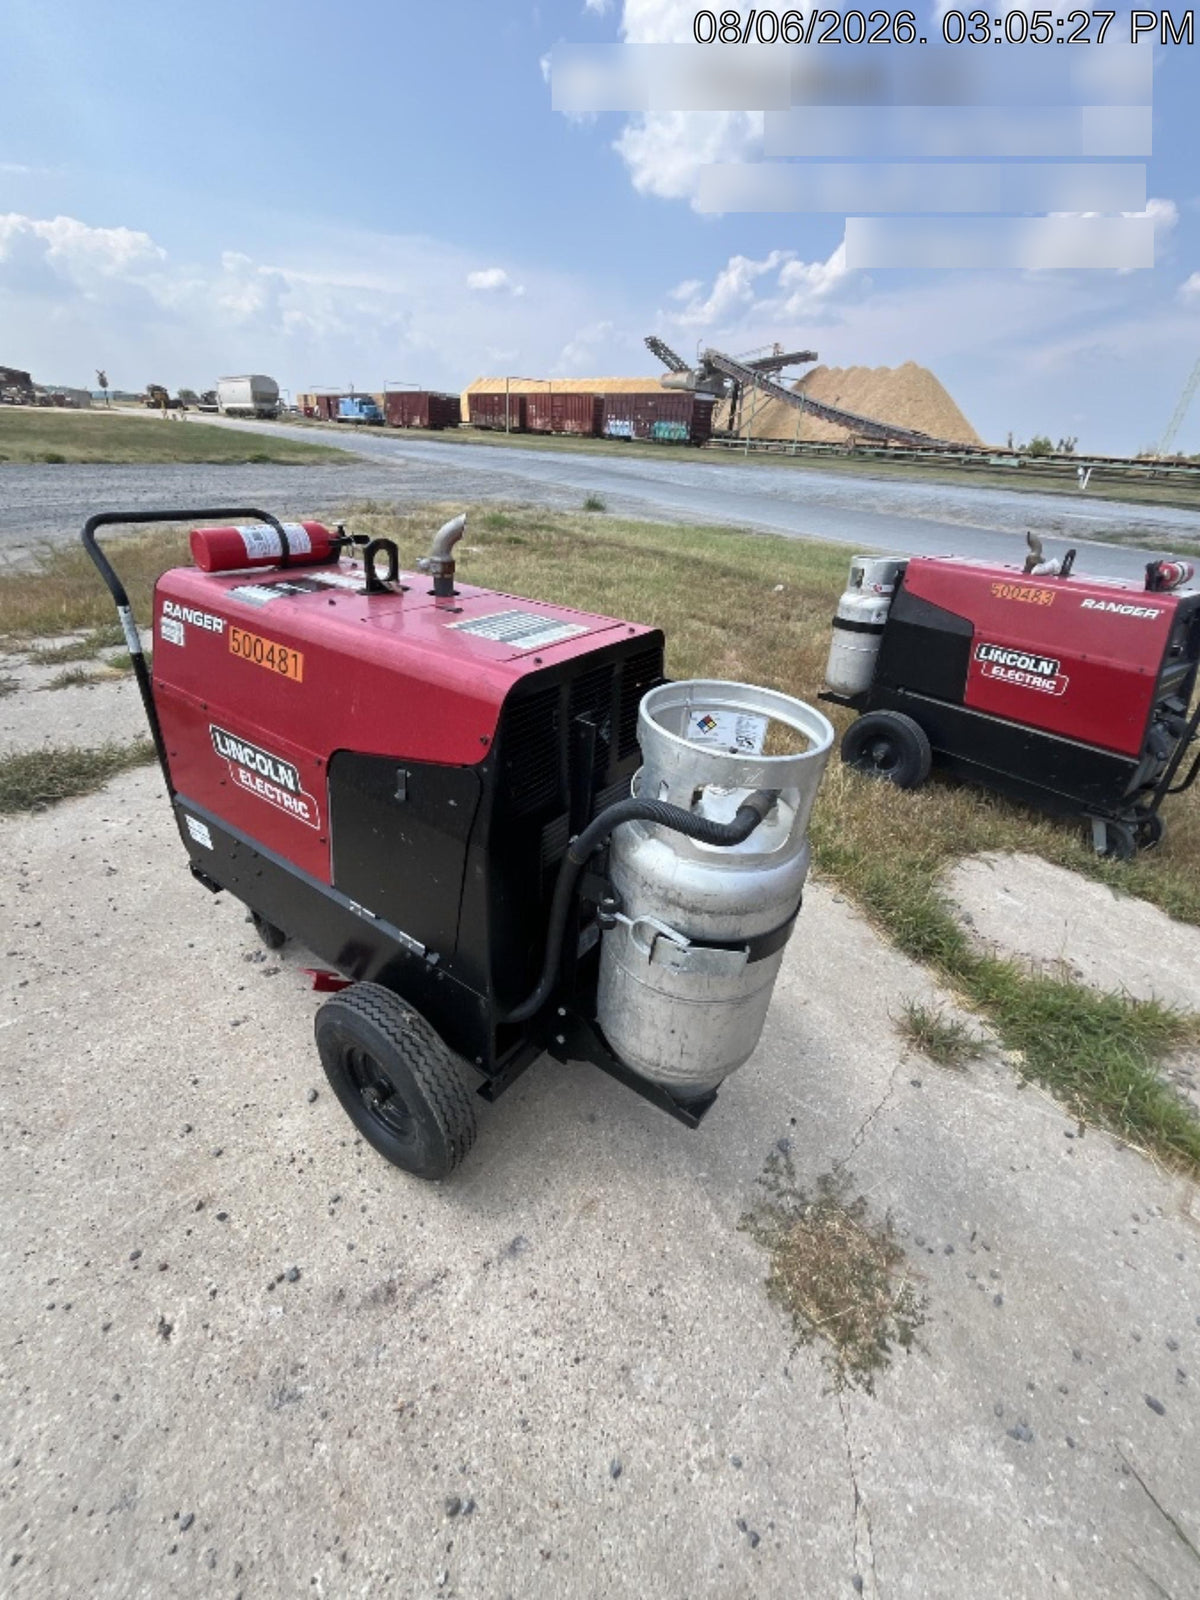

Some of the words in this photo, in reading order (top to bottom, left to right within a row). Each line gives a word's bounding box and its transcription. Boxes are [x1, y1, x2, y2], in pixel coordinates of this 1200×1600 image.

[991, 583, 1054, 605] 500483
[231, 628, 299, 678] 500481
[979, 647, 1054, 675] LINCOLN
[992, 666, 1056, 690] ELECTRIC
[214, 732, 296, 791] LINCOLN
[237, 767, 310, 819] ELECTRIC
